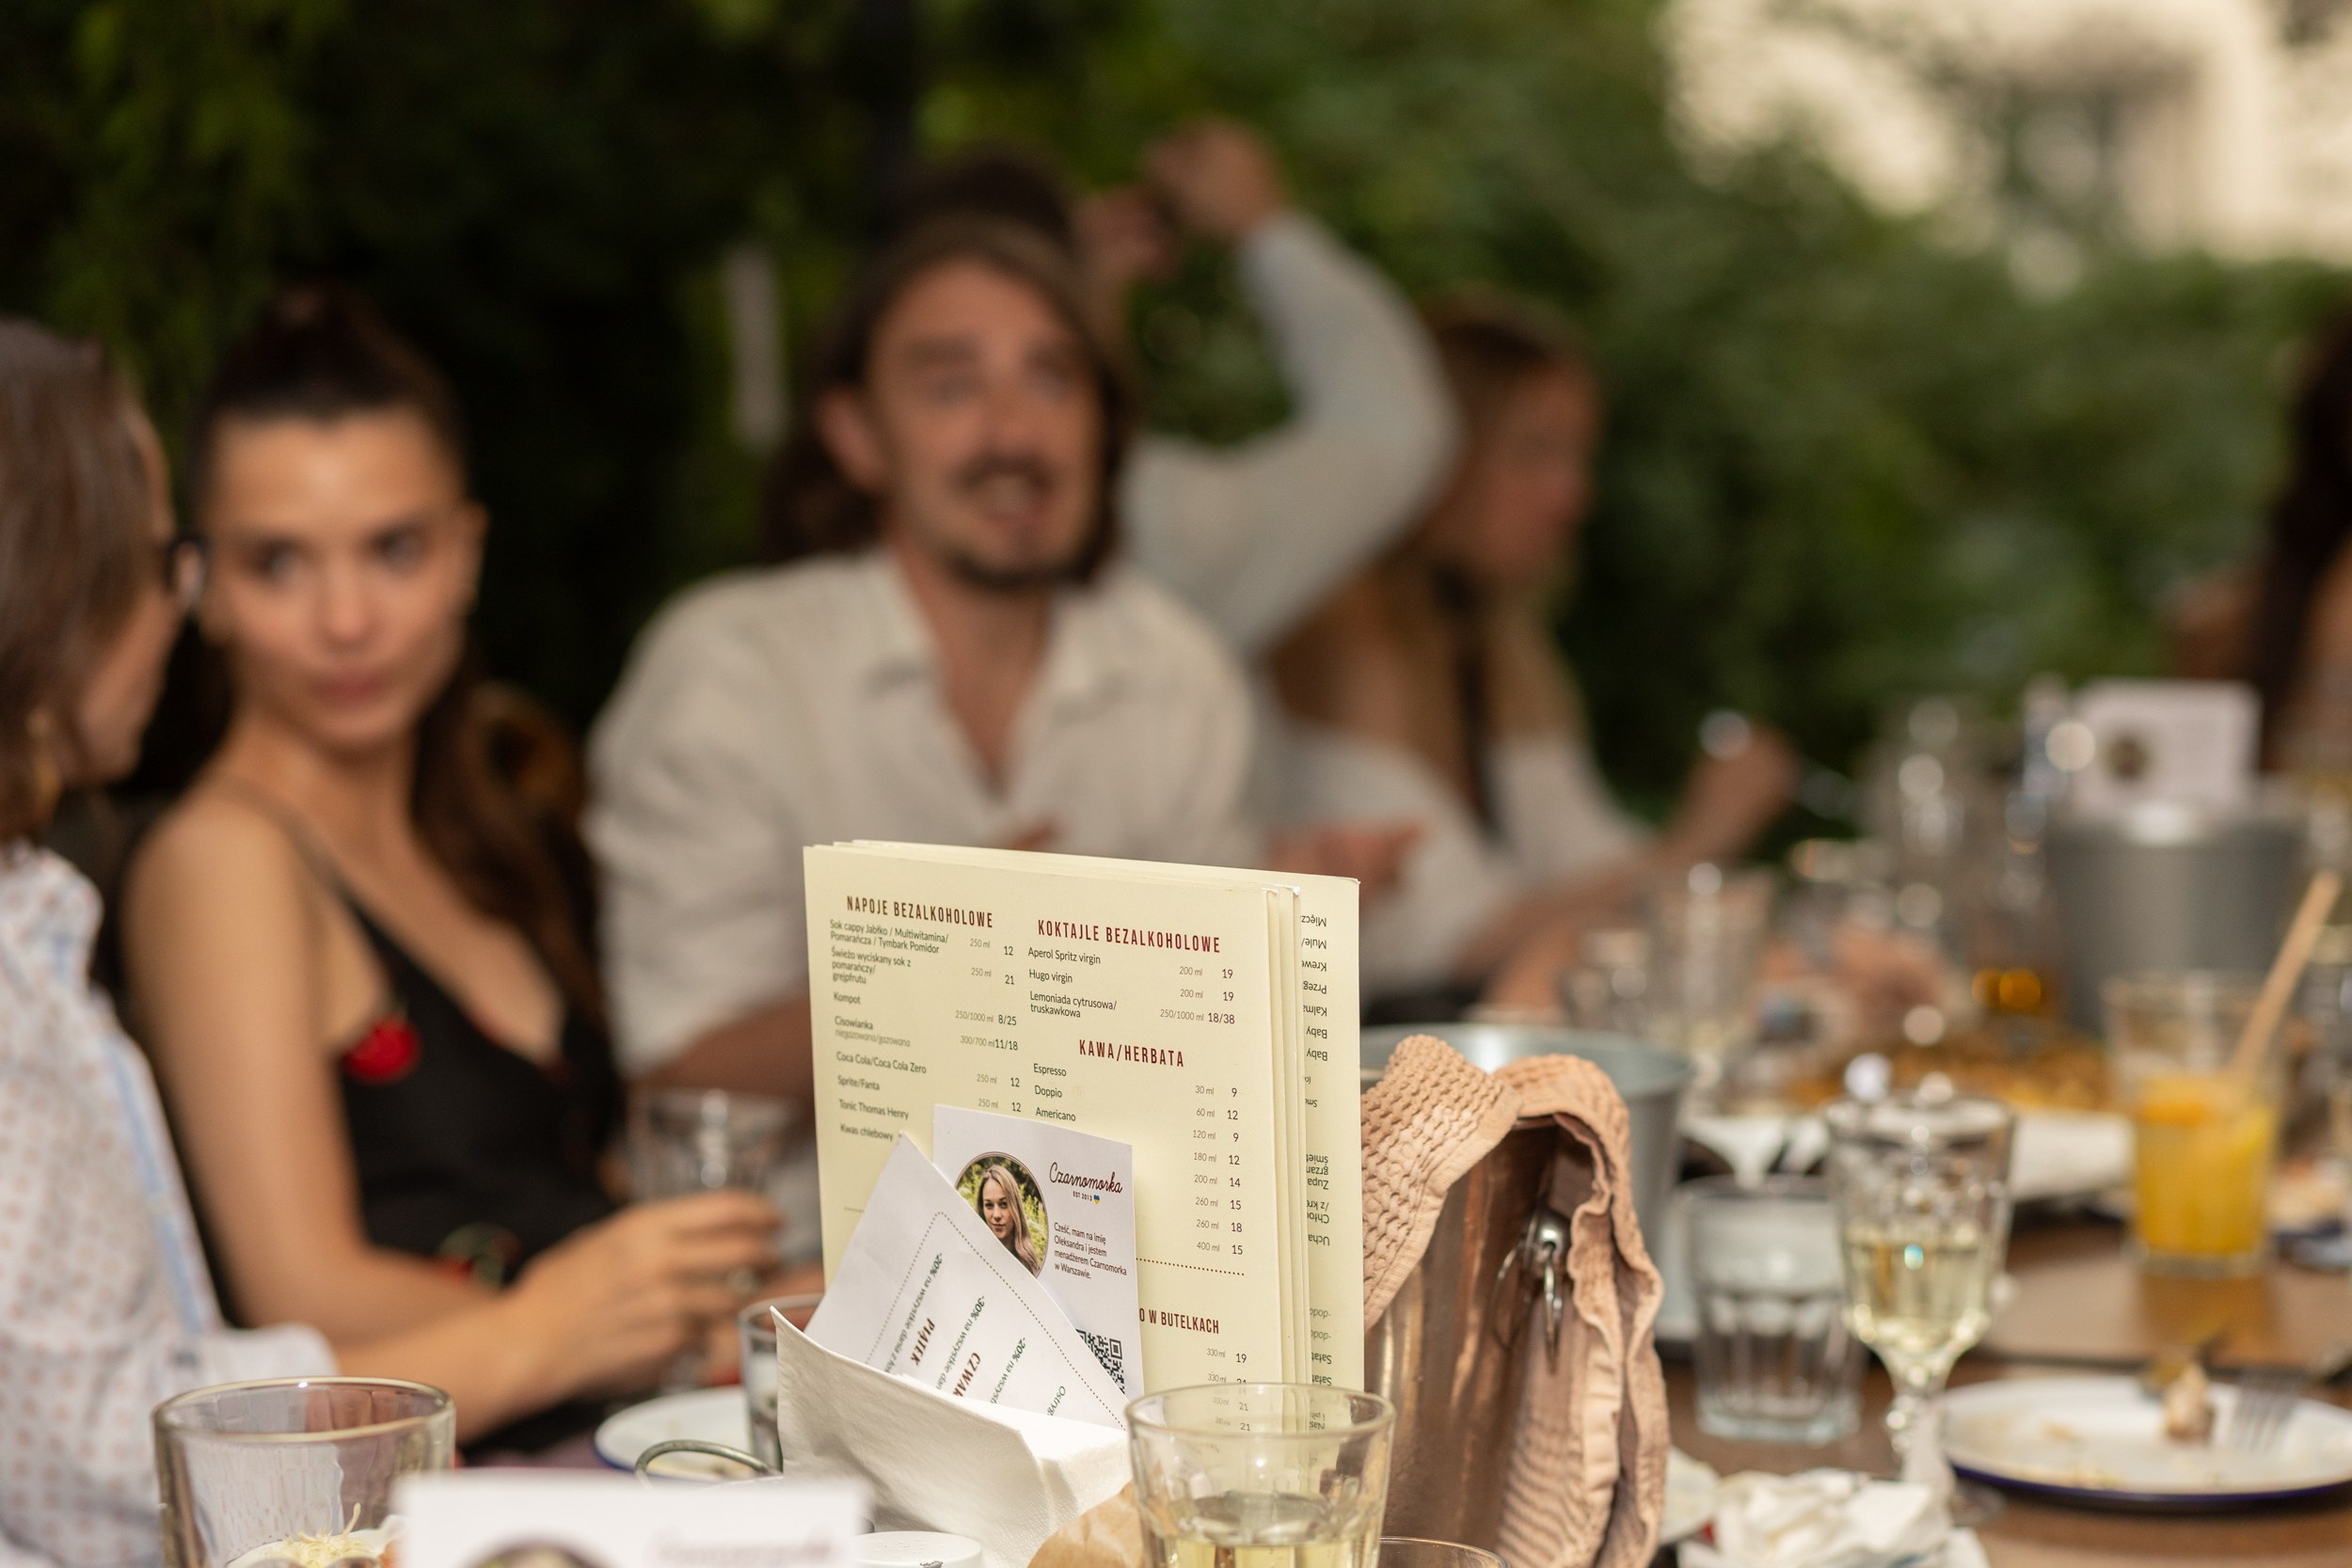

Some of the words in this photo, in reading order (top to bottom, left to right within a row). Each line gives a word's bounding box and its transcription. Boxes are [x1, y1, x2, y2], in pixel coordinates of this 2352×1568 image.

[847, 895, 888, 915] NAPOJE
[894, 901, 993, 928] BEZALKOHOLOWE
[1300, 914, 1327, 927] Mięcz
[830, 919, 843, 929] Sok
[844, 923, 865, 933] cappy
[866, 924, 887, 936] Jabłko
[895, 927, 949, 943] Multiwitamina/
[1038, 919, 1100, 942] KOKTAJLE
[1105, 927, 1220, 954] BEZALKOHOLOWE
[830, 931, 872, 945] Pomarańcza
[879, 937, 909, 950] Tymbark
[910, 941, 940, 954] Pomidor
[970, 939, 982, 948] 250
[983, 940, 991, 949] ml
[1004, 945, 1013, 957] 12
[832, 945, 855, 959] Świeżo
[857, 952, 892, 966] wyciskany
[894, 957, 905, 966] sok
[1027, 946, 1054, 960] Aperol
[1056, 950, 1077, 962] Spritz
[1078, 954, 1101, 966] virgin
[833, 973, 866, 984] grejpfrutu
[971, 967, 983, 976] 250
[984, 969, 992, 977] ml
[1005, 974, 1015, 986] 21
[1029, 969, 1050, 982] Hugo
[1052, 973, 1073, 985] virgin
[1179, 966, 1193, 976] 200
[1195, 967, 1203, 977] ml
[1222, 969, 1233, 979] 19
[834, 991, 861, 1006] Kompot
[1029, 990, 1072, 1006] Lemoniada
[1073, 997, 1117, 1011] cytrusowa/
[1180, 989, 1194, 998] 200
[1195, 990, 1204, 1000] ml
[1223, 991, 1234, 1002] 19
[956, 1010, 985, 1023] 250/1000
[986, 1014, 994, 1023] ml
[997, 1014, 1017, 1026] 8/25
[1031, 1003, 1081, 1019] truskawkowa
[1160, 1008, 1195, 1021] 250/1000
[1196, 1012, 1205, 1022] ml
[1208, 1012, 1235, 1025] 18/38
[834, 1016, 873, 1030] Cisowianka
[1306, 1026, 1327, 1038] Baby
[960, 1035, 987, 1048] 300/700
[988, 1038, 995, 1048] ml
[995, 1038, 1019, 1052] 11/18
[1079, 1038, 1184, 1068] KAWA/HERBATA
[1306, 1048, 1328, 1061] Baby
[836, 1051, 853, 1063] Coca
[855, 1053, 891, 1069] Cola/Coca
[893, 1059, 909, 1070] Cola
[910, 1063, 927, 1073] Zero
[1033, 1063, 1067, 1077] Espresso
[837, 1074, 881, 1091] Sprite/Fanta
[977, 1074, 989, 1084] 250
[990, 1075, 997, 1085] ml
[1010, 1077, 1020, 1088] 12
[1035, 1085, 1063, 1099] Doppio
[1195, 1085, 1204, 1094] 30
[1232, 1087, 1237, 1098] 9
[839, 1099, 858, 1113] Tonic
[858, 1102, 886, 1117] Thomas
[886, 1107, 910, 1121] Henry
[978, 1099, 990, 1109] 250
[992, 1100, 999, 1110] ml
[1012, 1102, 1022, 1113] 12
[1197, 1108, 1205, 1117] 60
[1206, 1109, 1216, 1117] ml
[1227, 1110, 1238, 1120] 12
[1036, 1107, 1076, 1122] Americano
[840, 1123, 859, 1135] Kwas
[860, 1127, 894, 1142] chlebowy
[1193, 1130, 1206, 1139] 120
[1208, 1132, 1216, 1140] ml
[1232, 1132, 1239, 1143] 9
[1194, 1152, 1207, 1162] 180
[1208, 1154, 1216, 1163] ml
[1229, 1155, 1240, 1165] 12
[1050, 1162, 1123, 1194] Czarnomorka
[1194, 1174, 1208, 1184] 200
[1209, 1176, 1217, 1185] ml
[1230, 1178, 1241, 1188] 14
[1308, 1178, 1329, 1190] Zupa
[1195, 1196, 1209, 1207] 260
[1210, 1198, 1218, 1208] ml
[1231, 1200, 1241, 1211] 15
[1054, 1223, 1071, 1235] Cześć,
[1072, 1228, 1085, 1239] mam
[1086, 1232, 1093, 1241] na
[1094, 1232, 1106, 1245] imię
[1197, 1219, 1210, 1229] 260
[1211, 1221, 1219, 1230] ml
[1231, 1223, 1243, 1233] 18
[1054, 1235, 1084, 1251] Oleksandra
[1088, 1245, 1107, 1257] jestem
[1308, 1234, 1330, 1246] Ucha
[1197, 1242, 1210, 1252] 400
[1212, 1243, 1220, 1253] ml
[1232, 1245, 1244, 1255] 15
[930, 1252, 943, 1277] -20%
[1055, 1262, 1060, 1271] w
[1061, 1263, 1091, 1279] Warszawie.
[1089, 1259, 1127, 1276] Czarnomorka
[924, 1275, 932, 1288] na
[905, 1289, 926, 1329] wszystkie
[971, 1295, 985, 1321] -30%
[963, 1319, 973, 1331] na
[1149, 1309, 1157, 1324] W
[1161, 1311, 1219, 1334] BUTELKACH
[894, 1329, 908, 1354] dania
[911, 1317, 935, 1366] PIĄTEK
[945, 1332, 967, 1373] wszystkie
[1012, 1337, 1025, 1363] -20%
[1206, 1349, 1218, 1357] 330
[1218, 1350, 1226, 1358] ml
[1236, 1354, 1247, 1364] 19
[1006, 1360, 1014, 1373] na
[1208, 1373, 1219, 1382] 330
[1047, 1386, 1066, 1417] Ostryg
[1239, 1402, 1248, 1412] 21
[1240, 1422, 1251, 1432] 21
